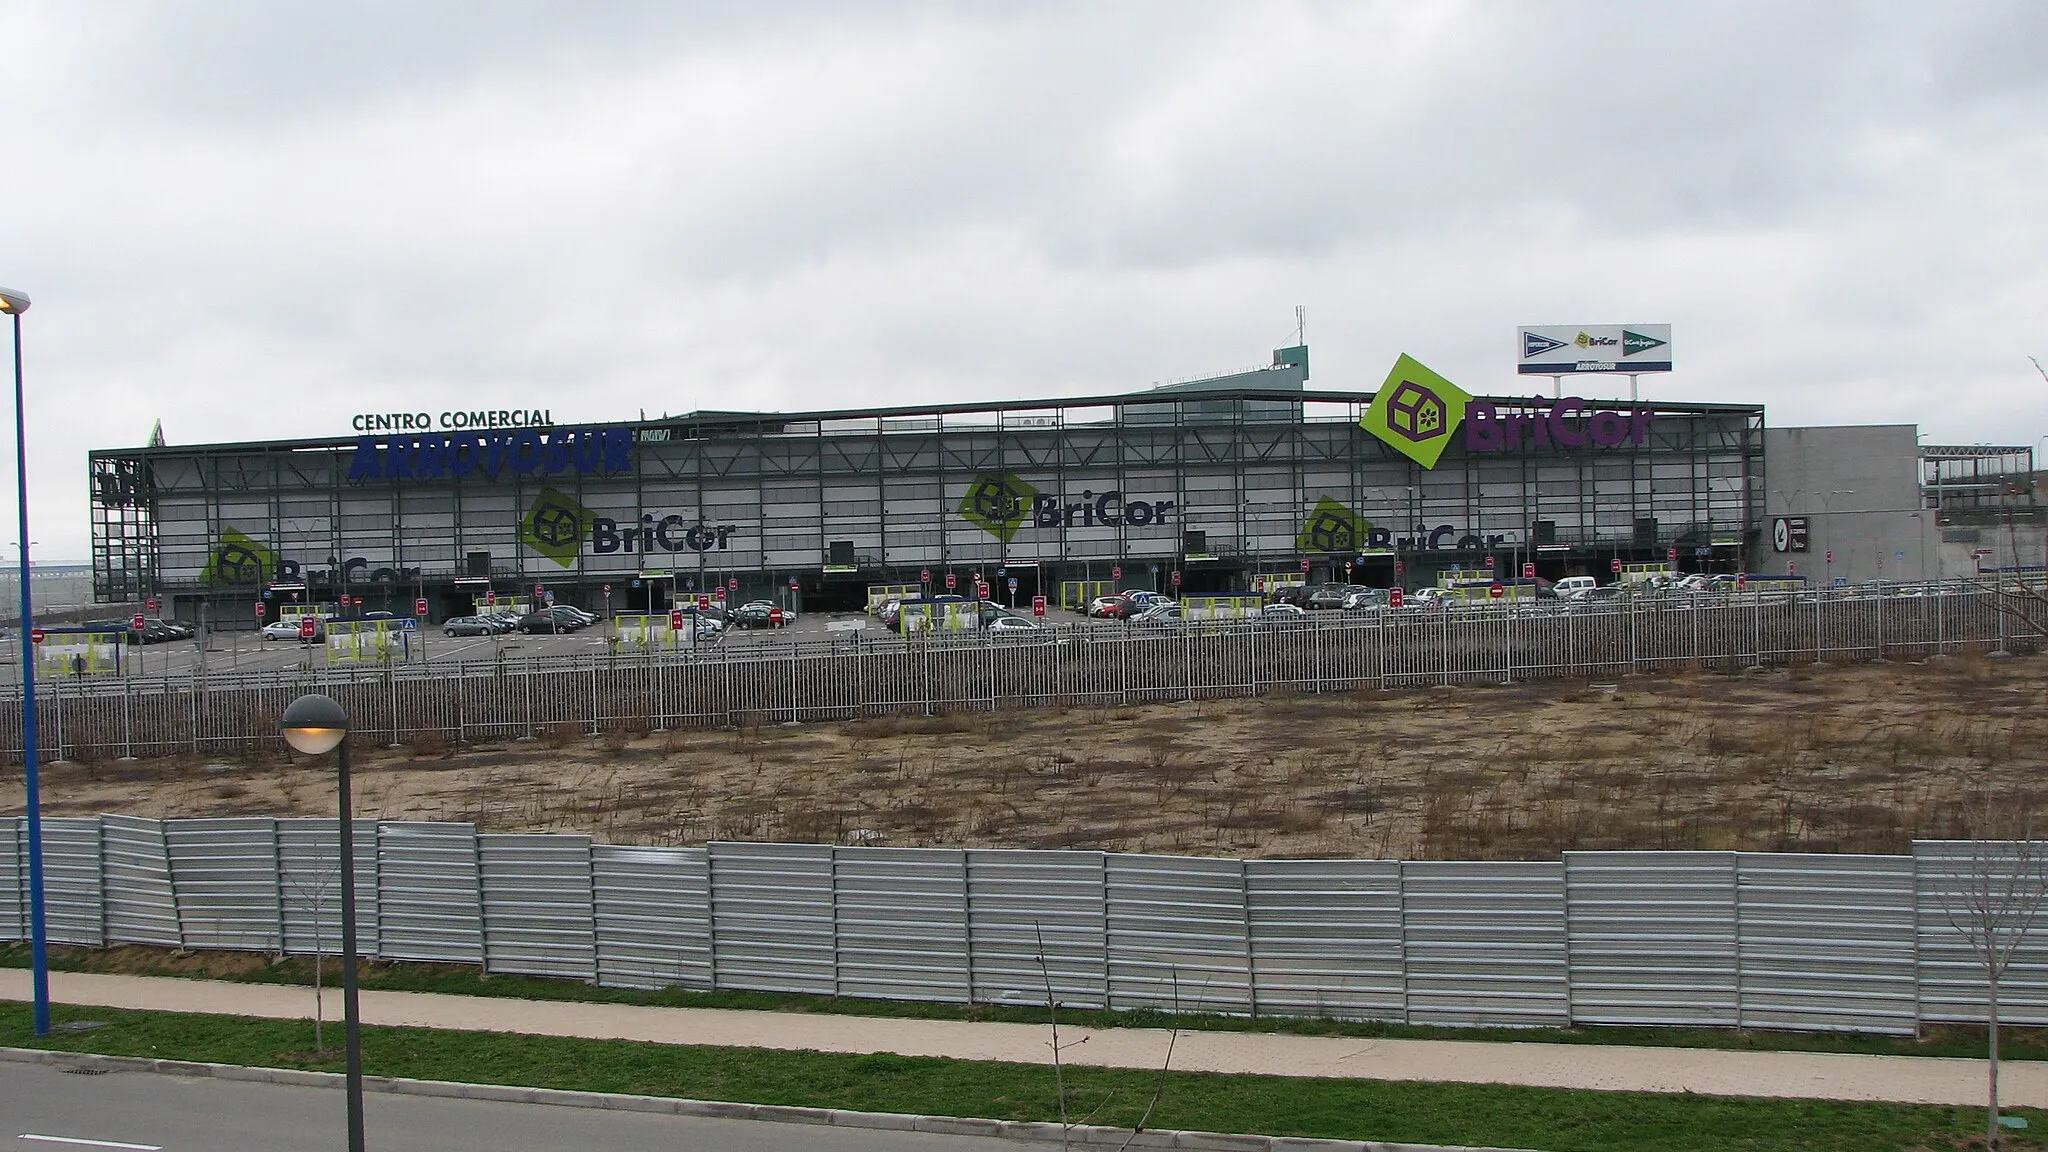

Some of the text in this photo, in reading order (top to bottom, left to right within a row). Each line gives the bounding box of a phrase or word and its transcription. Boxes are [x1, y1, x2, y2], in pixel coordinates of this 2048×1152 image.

[353, 409, 553, 431] CENTRO COMERCIAL
[1466, 396, 1654, 451] BriCor
[350, 428, 632, 479] ARROYOSUR
[1034, 490, 1174, 527] BriCor
[593, 513, 736, 553] BriCor
